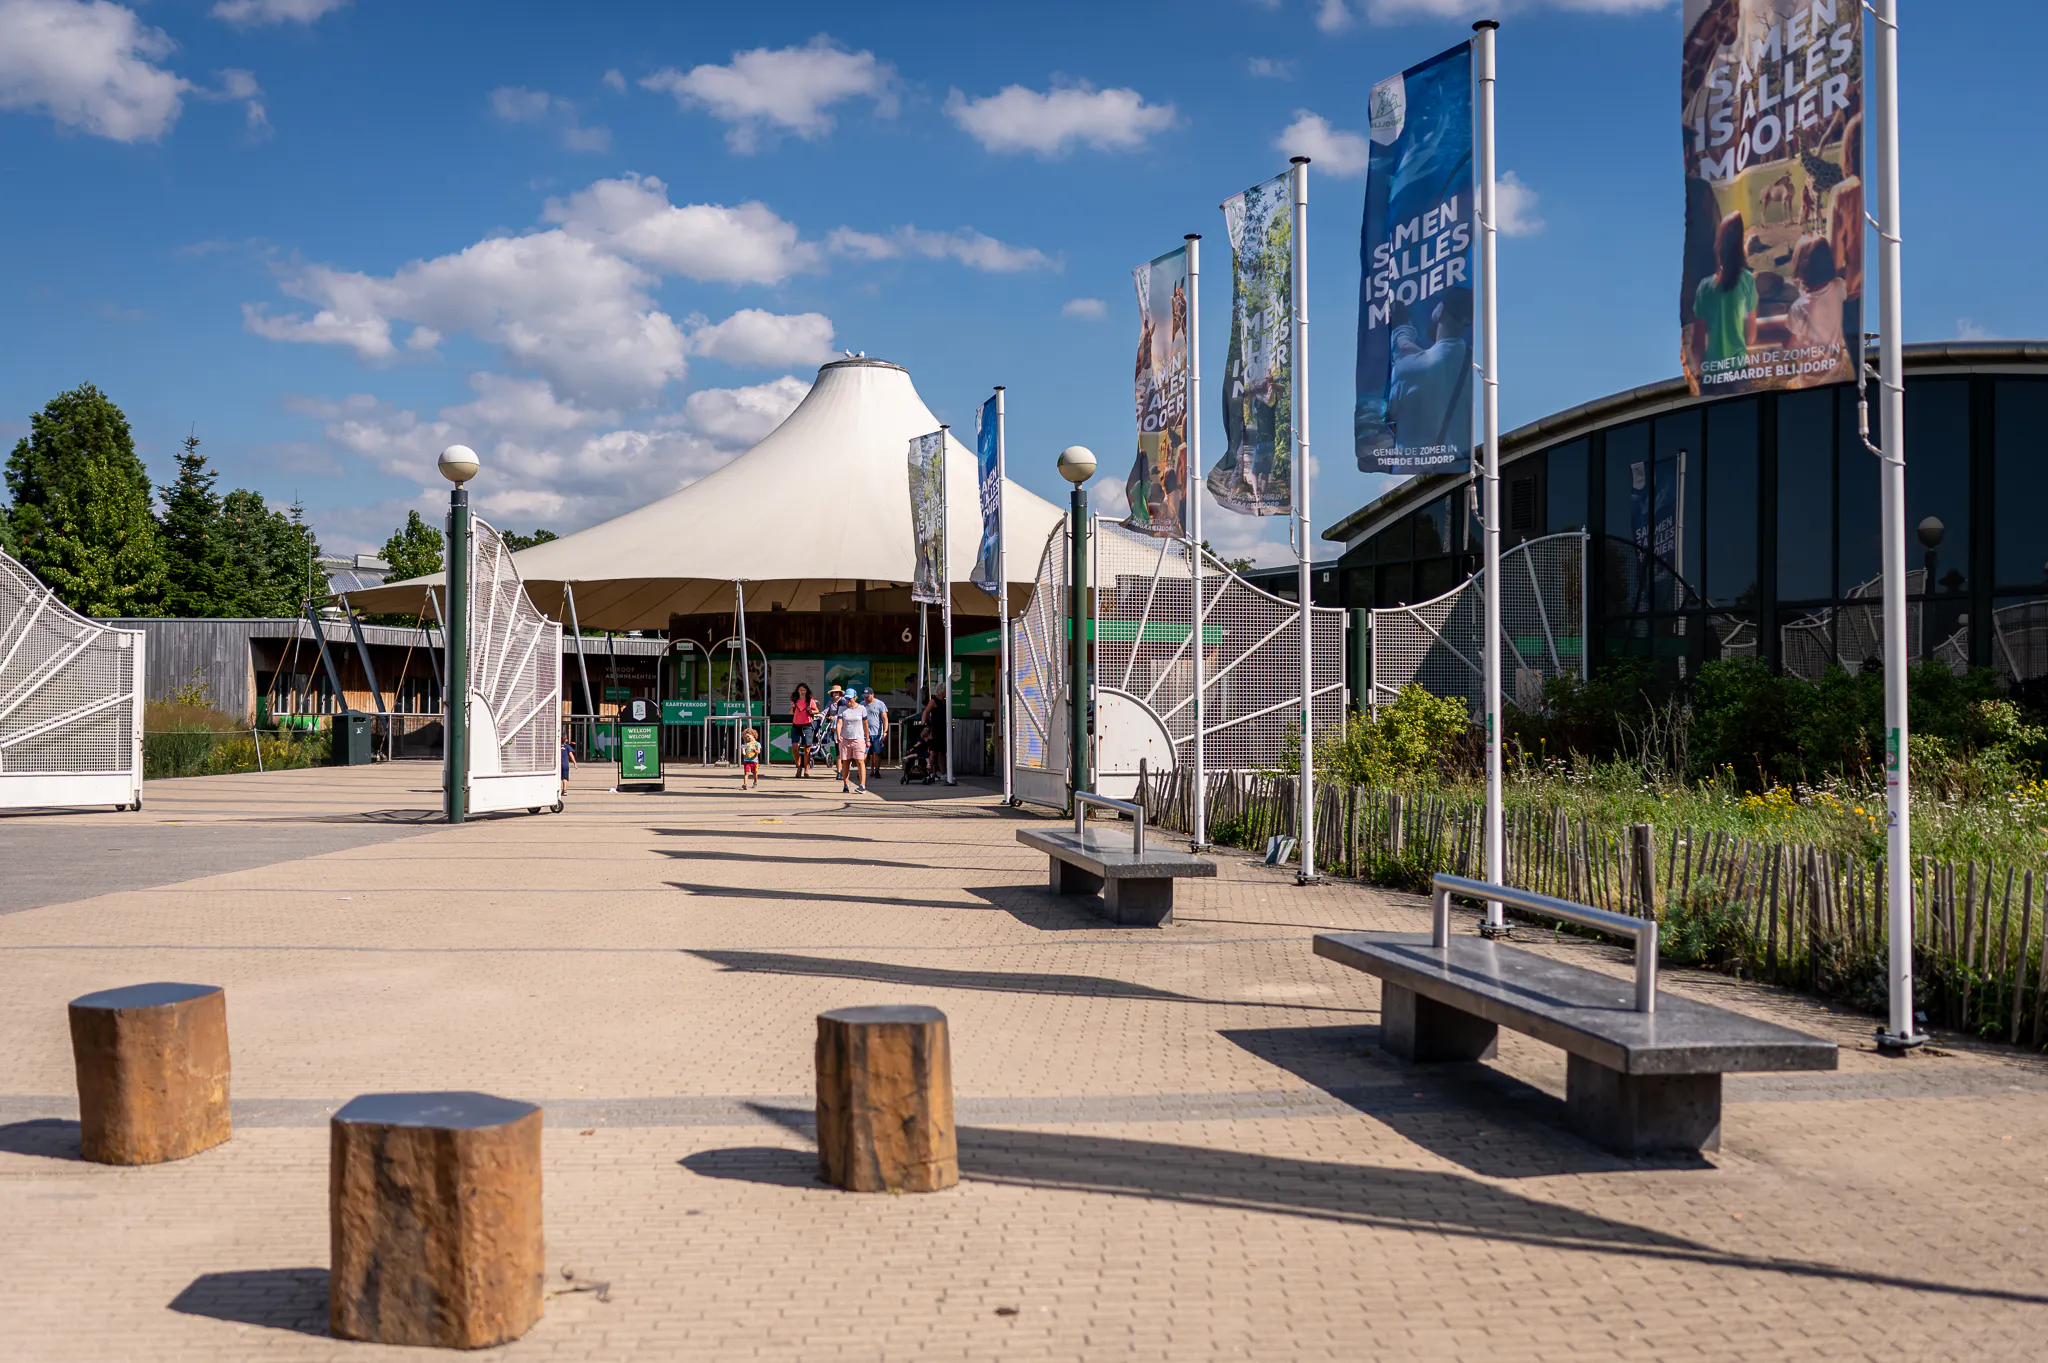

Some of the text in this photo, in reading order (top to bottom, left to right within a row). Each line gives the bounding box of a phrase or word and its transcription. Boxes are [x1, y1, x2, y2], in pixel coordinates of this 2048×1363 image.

[1708, 0, 1836, 104] SAMEN
[1695, 23, 1854, 153] IS ALLES
[1700, 73, 1851, 184] MOOIER
[1388, 222, 1470, 280] ALLES
[1700, 342, 1841, 372] GENIET VAN DE ZOMER IN
[1702, 358, 1837, 385] DIERGAARDE BLIJDORP
[1414, 455, 1455, 466] BLIJDORP
[1419, 445, 1446, 456] ZOMER
[1447, 444, 1458, 453] IN
[707, 627, 913, 643] 1 6
[637, 750, 644, 758] P
